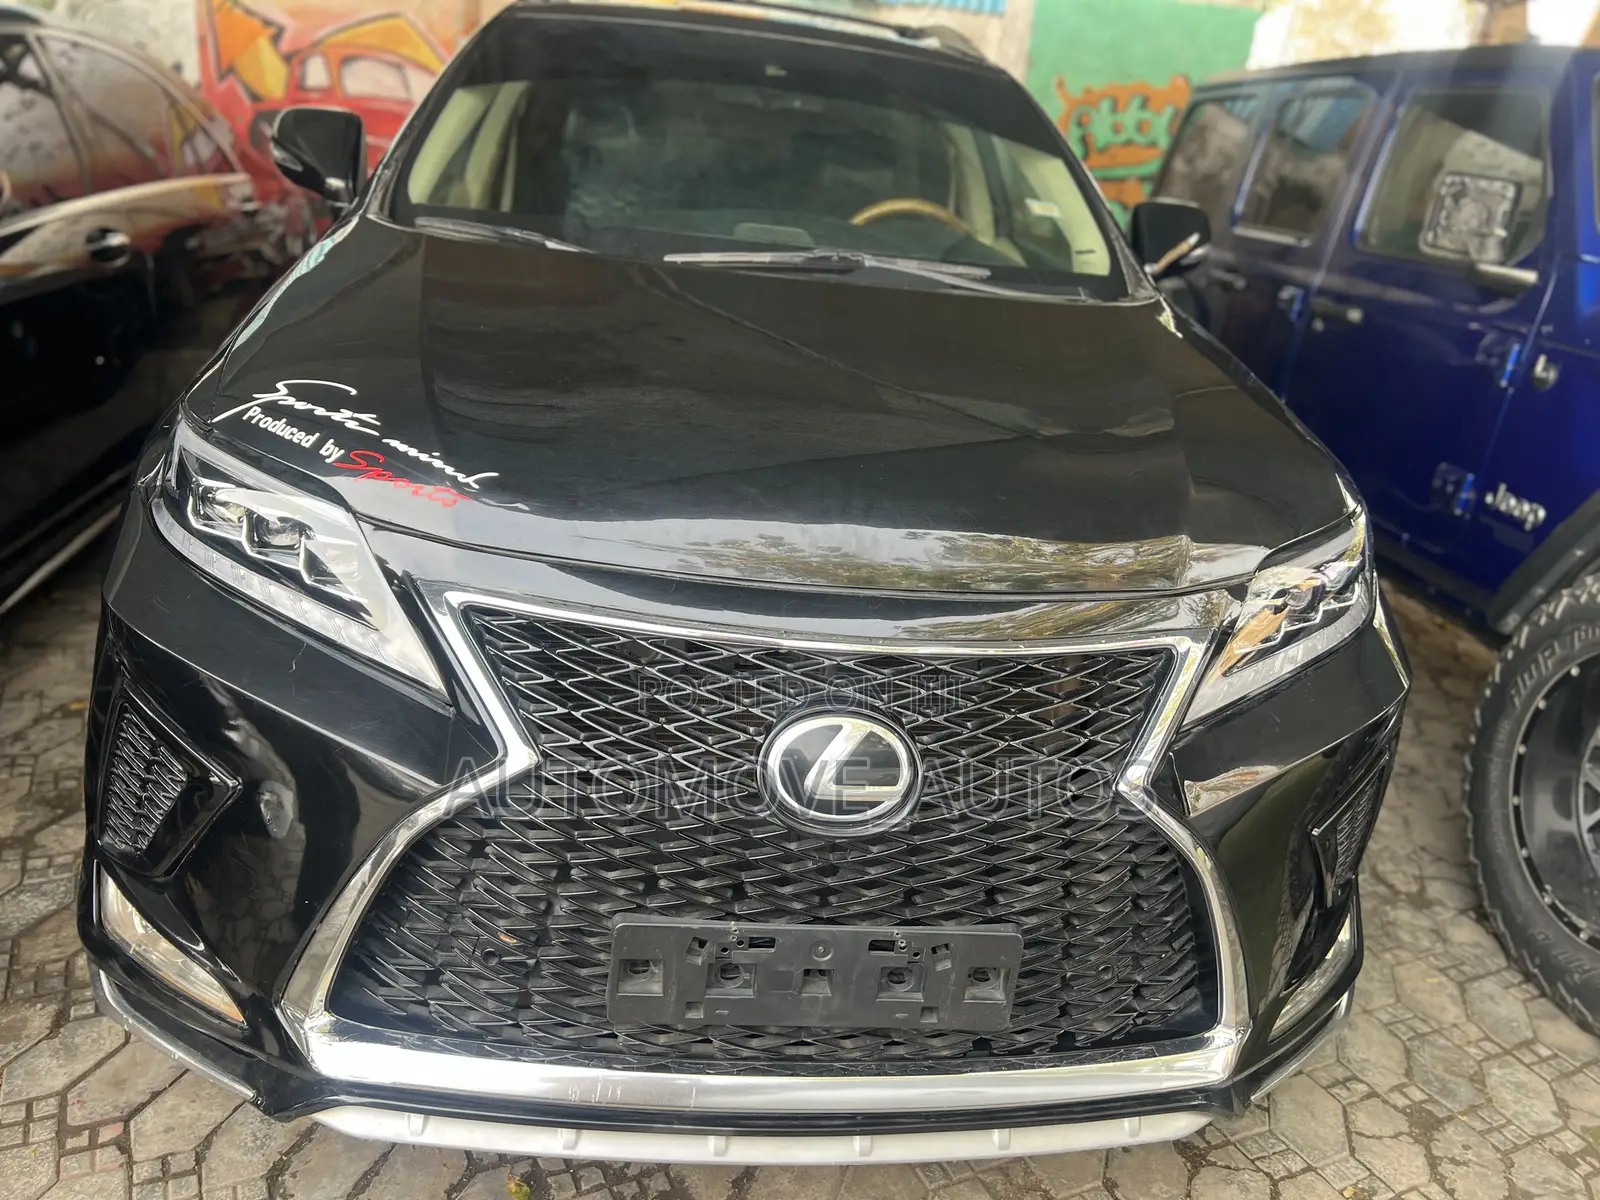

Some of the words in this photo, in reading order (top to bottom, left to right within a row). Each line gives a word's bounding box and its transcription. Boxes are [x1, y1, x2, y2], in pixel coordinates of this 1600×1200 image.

[243, 405, 320, 449] Produced
[319, 438, 345, 464] by
[334, 450, 471, 508] Sports
